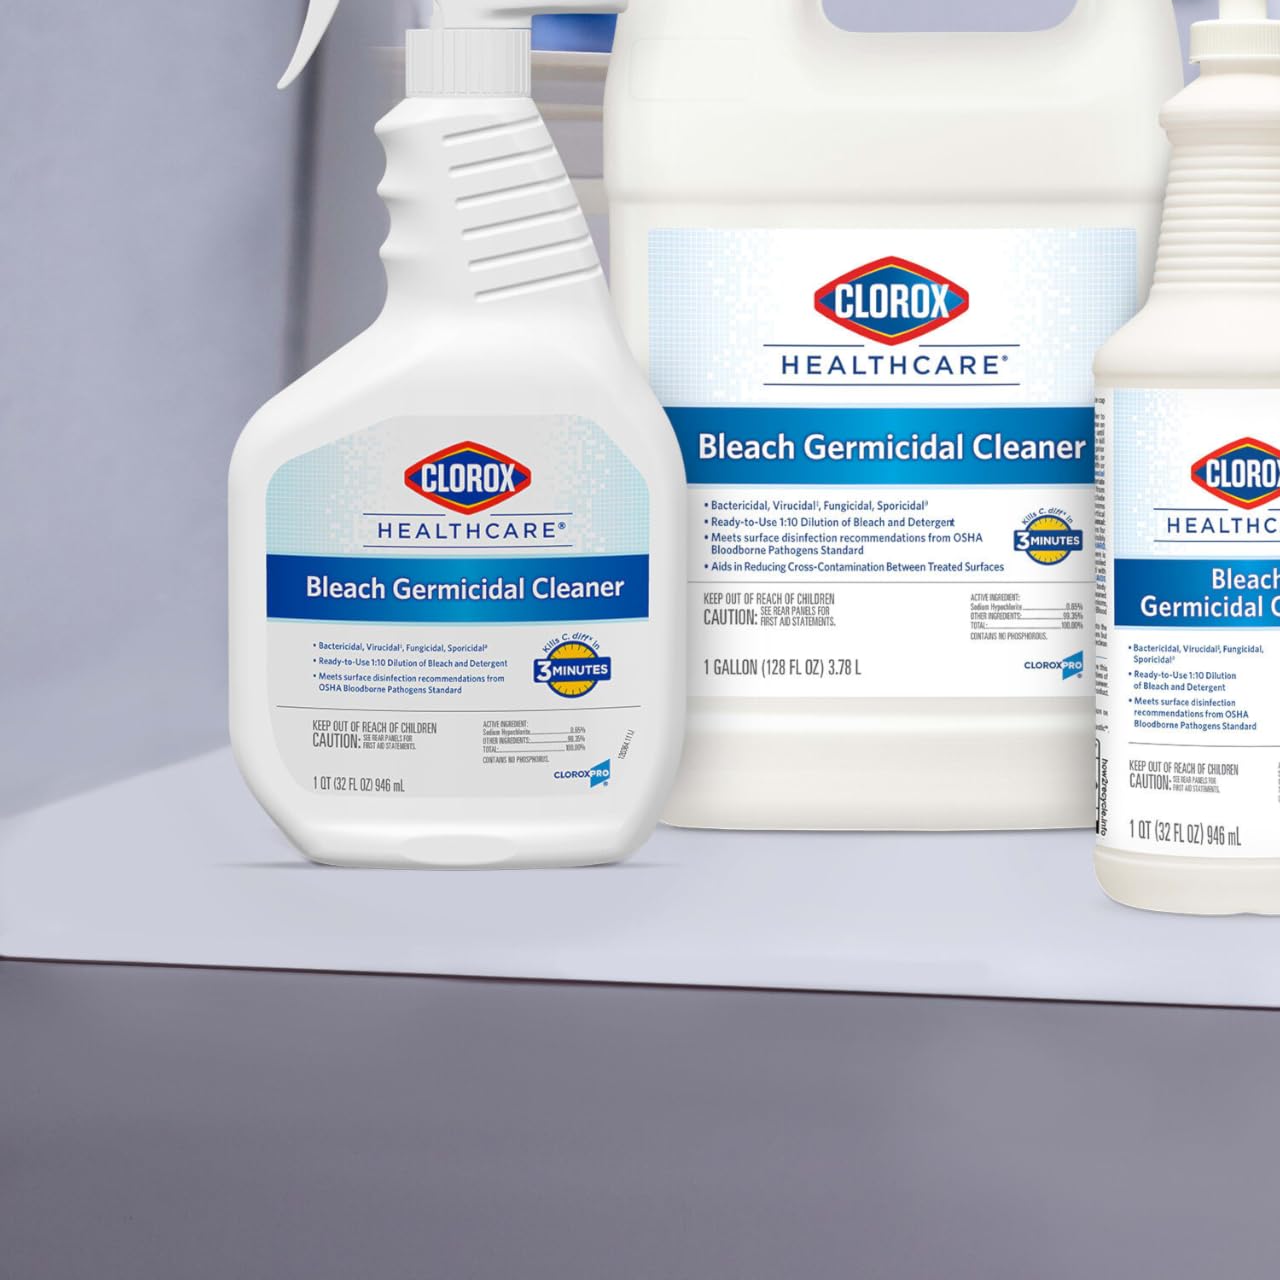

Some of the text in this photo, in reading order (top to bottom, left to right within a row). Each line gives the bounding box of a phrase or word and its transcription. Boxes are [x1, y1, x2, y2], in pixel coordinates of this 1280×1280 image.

[835, 283, 949, 318] CLOROX
[700, 433, 1086, 460] Bleach Germicidal Cleaner
[422, 463, 515, 493] CLOROX
[711, 501, 771, 512] Bactericidal,
[824, 501, 875, 512] Fungicidal,
[711, 517, 955, 529] Ready-to-Use 1:10 Dilution of Bleach and Detergent
[711, 533, 983, 542] Meets surface disinfection recommendations from OSHA
[1016, 531, 1080, 550] 3 MINUTES
[711, 545, 864, 557] Bloodborne Pathogens Standard
[711, 562, 1005, 573] Aids in Reducing Cross-Contamination Between Treated Surfaces
[307, 575, 625, 600] Bleach Germicidal Cleaner
[704, 593, 835, 604] KEEP OUT OF REACH OF CHILDREN
[761, 606, 830, 616] SEE REAR PANELS FOR
[1141, 595, 1263, 617] Germicidal
[704, 609, 758, 625] CAUTION:
[761, 617, 836, 627] FIRST AID STATEMENTS.
[319, 641, 365, 651] Bactericidal,
[406, 644, 446, 653] Fungicidal,
[1133, 643, 1182, 654] Bactericidal,
[1223, 645, 1264, 655] Fungicidal,
[319, 657, 370, 667] Ready-to-Use
[371, 658, 386, 667] 1:10
[387, 659, 418, 667] Dilution
[420, 659, 427, 667] of
[470, 660, 508, 669] Detergent
[703, 658, 862, 678] 1 GALLON (128 FL OZ) 3.78 L
[536, 661, 608, 681] 3 MINUTES
[1134, 670, 1237, 680] Ready-to-Use 1:10 Dilution
[319, 672, 505, 683] Meets surface disinfection recommendations from
[319, 683, 462, 695] OSHA Bloodborne Pathogens Standard
[1133, 681, 1226, 693] of Bleach and Detergent
[1134, 697, 1236, 707] Meets surface disinfection
[1134, 709, 1249, 719] recommendations from OSHA
[313, 720, 437, 734] KEEP OUT OF REACH OF CHILDREN
[1134, 720, 1257, 731] Bloodborne Pathogens Standard
[313, 732, 361, 748] CAUTION:
[1129, 760, 1238, 776] KEEP OUT OF REACH OF CHILDREN
[314, 776, 405, 792] 1 QT (32 FL OZ) 946 mL
[1130, 773, 1171, 790] CAUTION:
[1130, 819, 1241, 846] 1 QT (32 FL OZ) 946 mL
